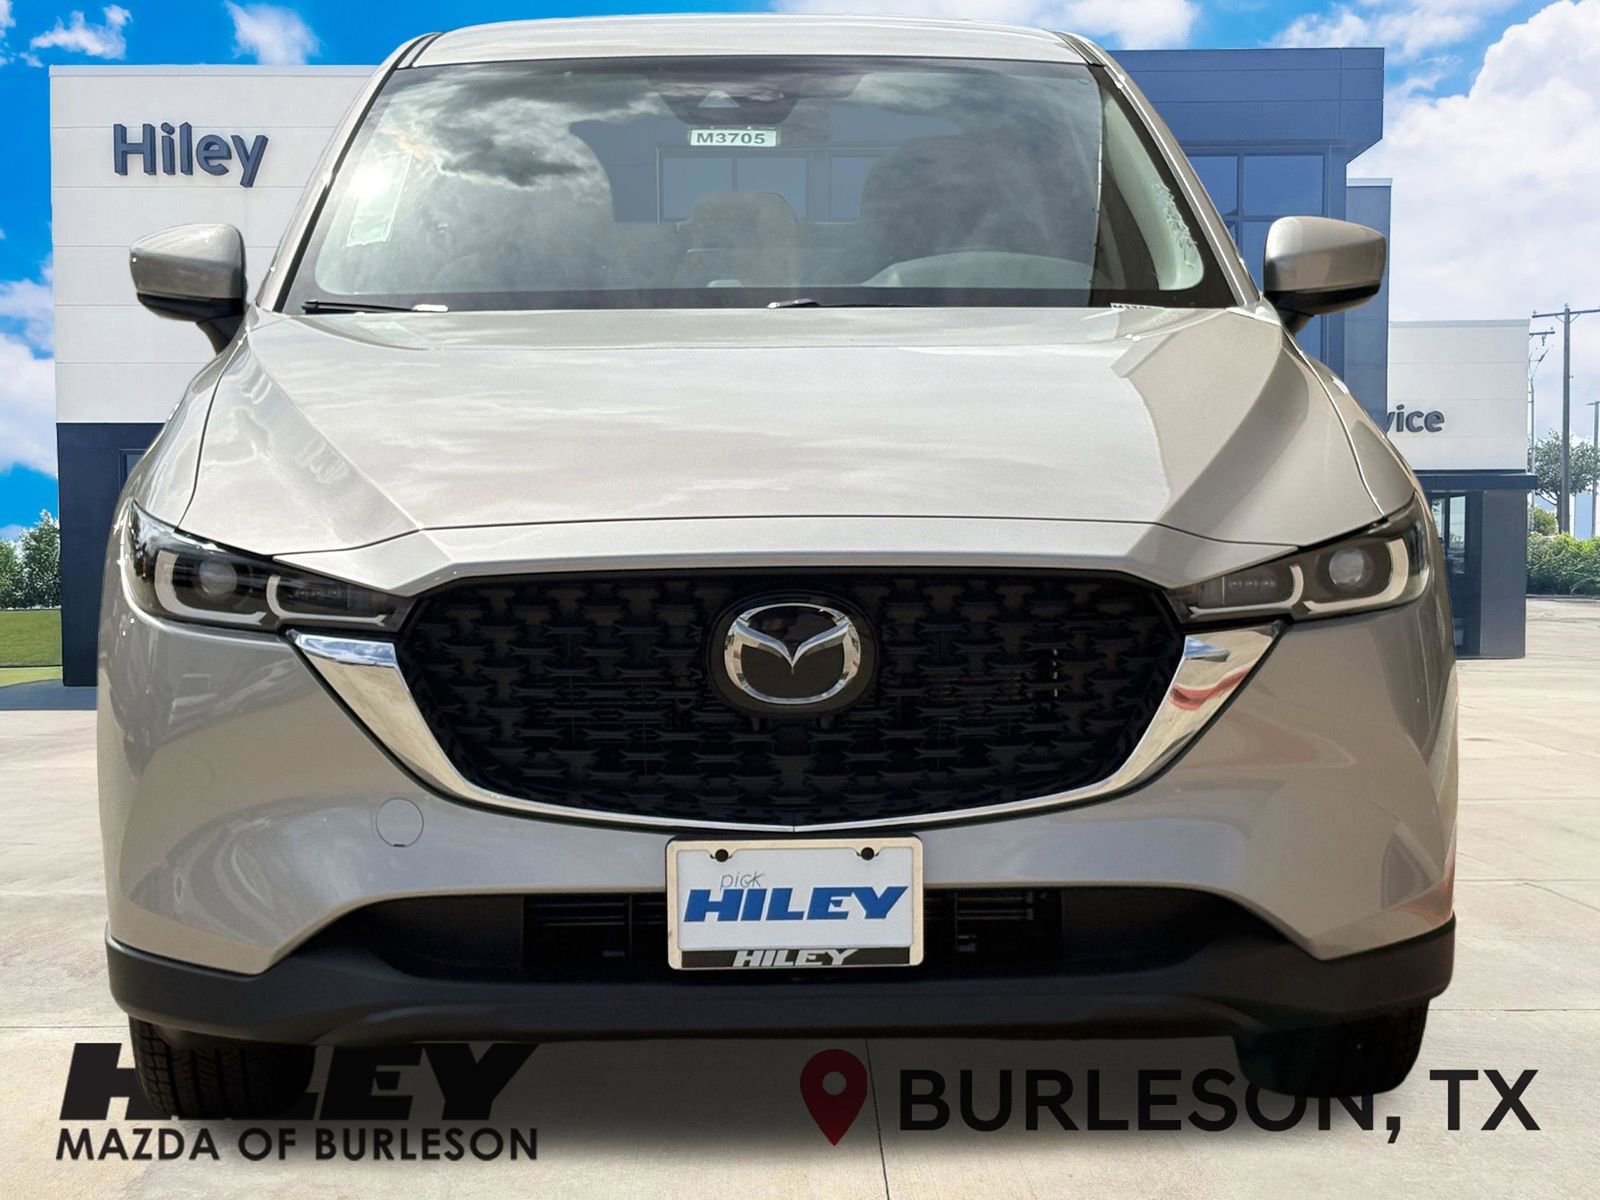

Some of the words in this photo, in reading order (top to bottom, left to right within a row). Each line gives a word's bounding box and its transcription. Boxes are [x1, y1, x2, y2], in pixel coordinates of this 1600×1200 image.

[696, 132, 766, 145] M3705
[113, 121, 269, 188] Hiley
[719, 871, 766, 892] pick
[684, 885, 909, 923] HILEY
[732, 948, 859, 968] HILEY
